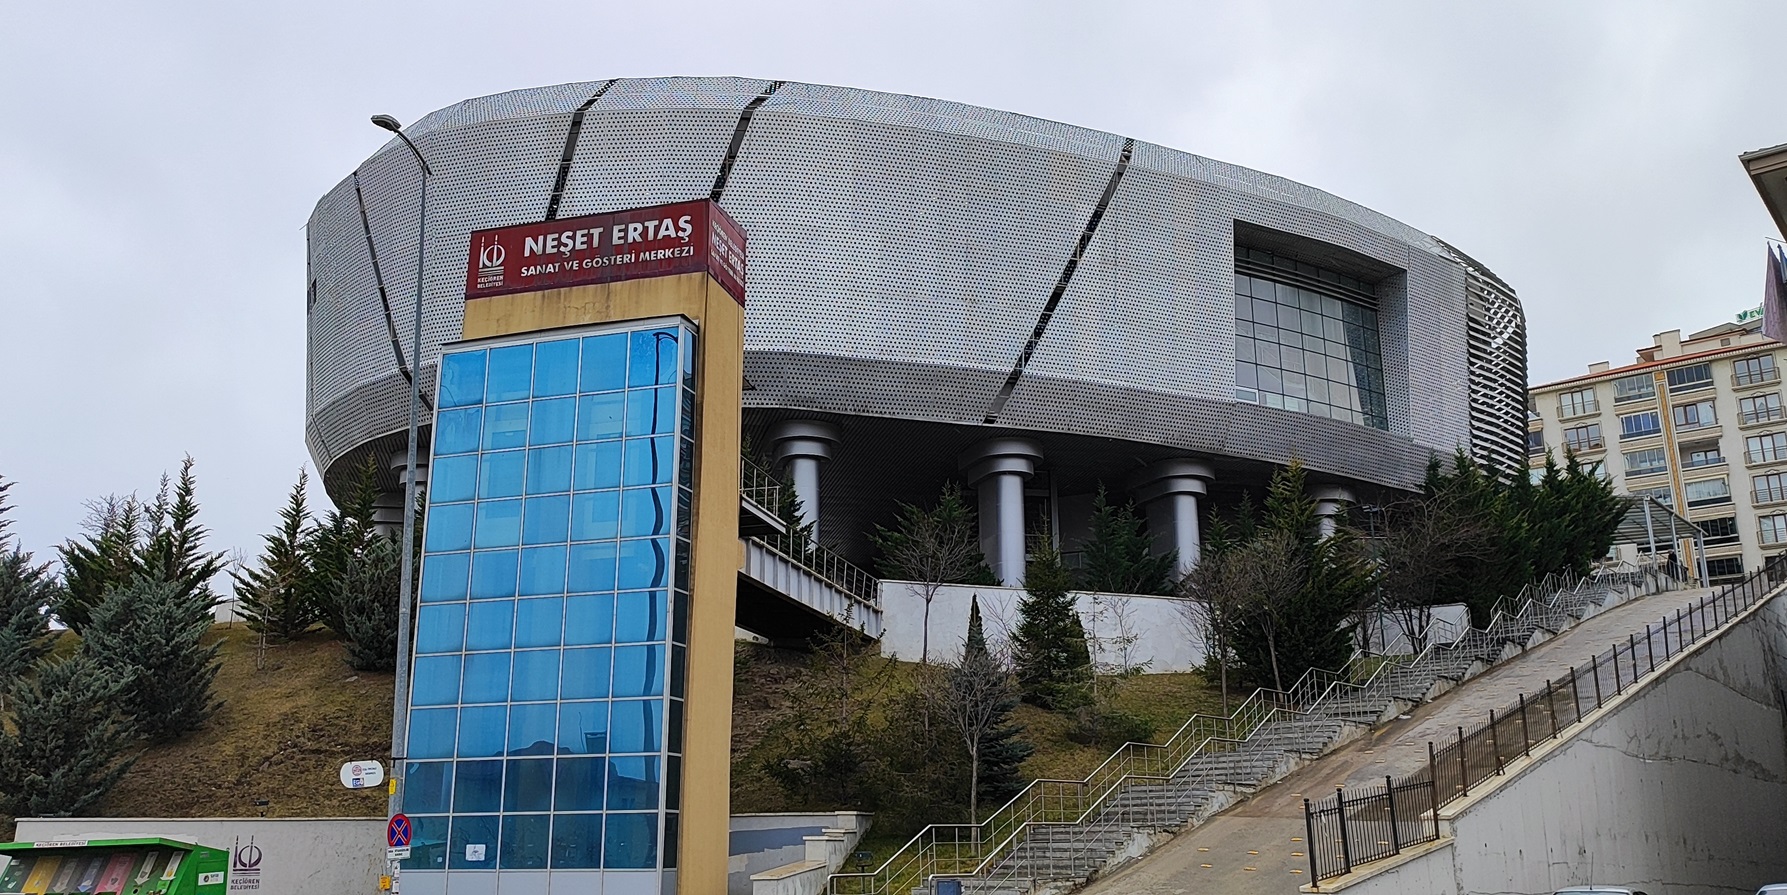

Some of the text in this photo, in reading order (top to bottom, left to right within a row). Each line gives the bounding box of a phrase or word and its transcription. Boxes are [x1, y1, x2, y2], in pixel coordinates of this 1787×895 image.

[523, 215, 693, 258] NEŞET ERTAŞ
[520, 243, 695, 277] SANAT VE GÖSTERİ MERKEZİ
